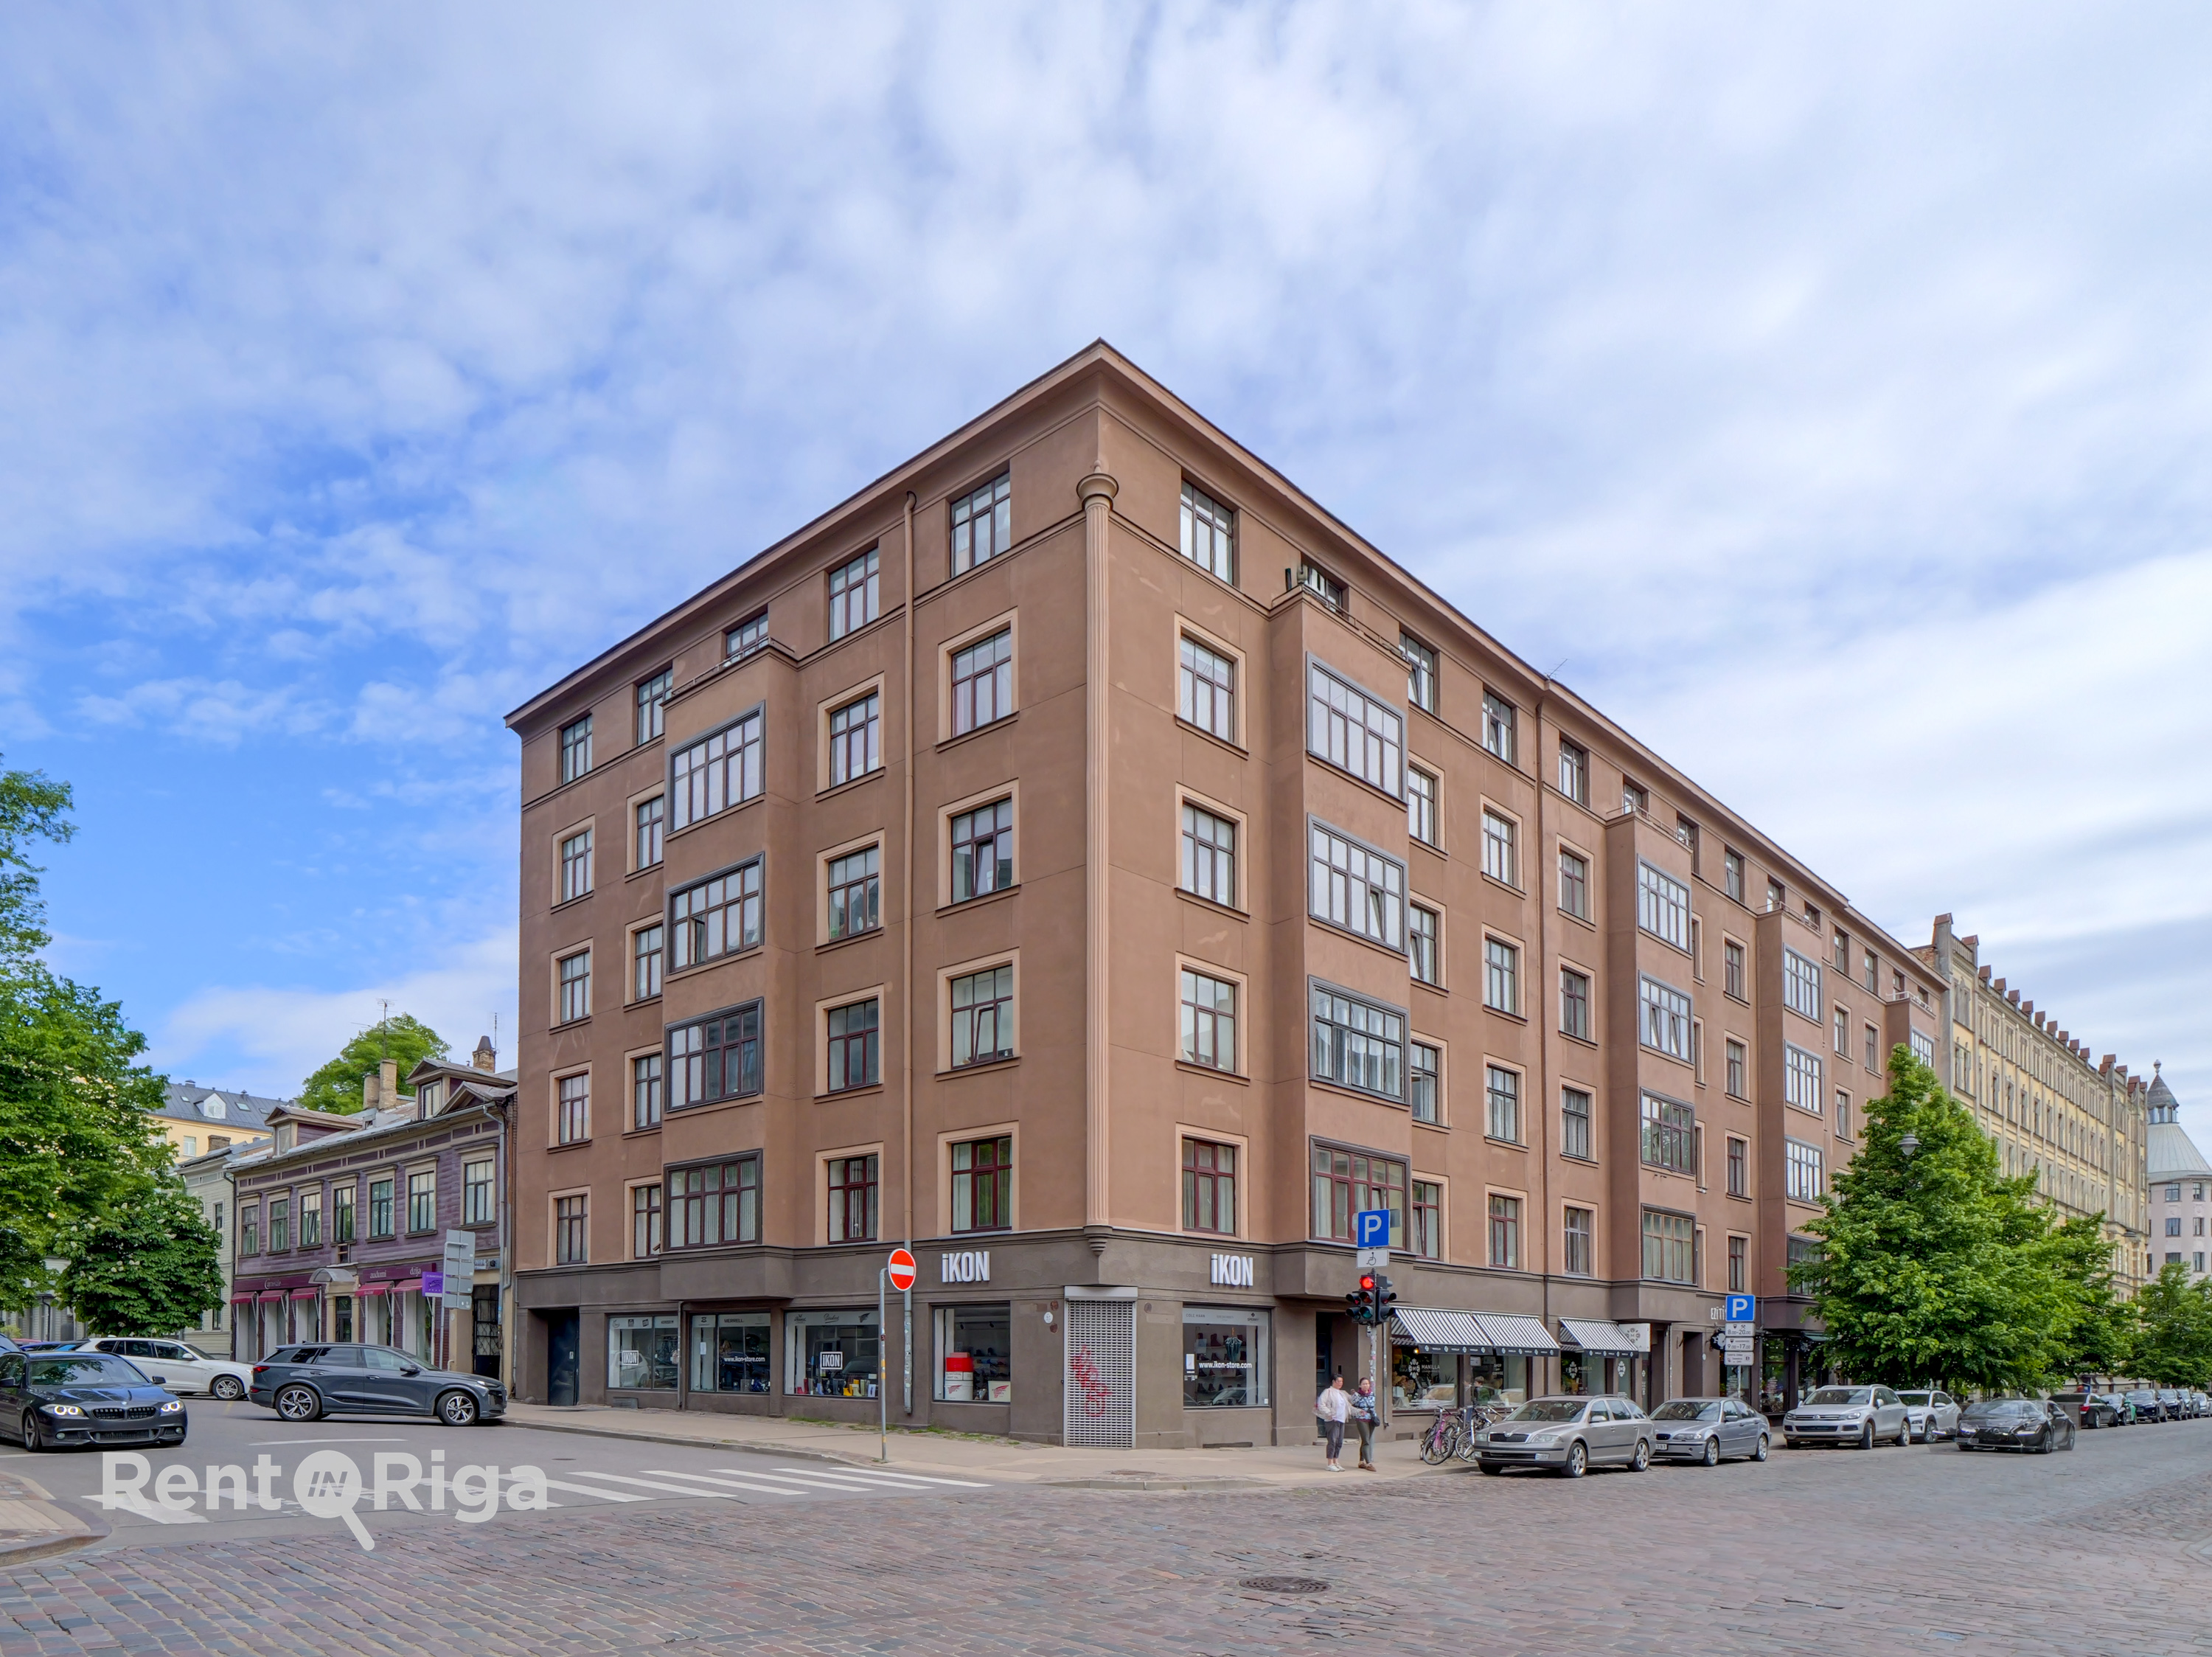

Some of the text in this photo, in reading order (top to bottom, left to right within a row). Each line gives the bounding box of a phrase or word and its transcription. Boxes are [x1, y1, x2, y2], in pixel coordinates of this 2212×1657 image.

[1364, 1215, 1382, 1243] P
[1732, 1298, 1748, 1319] P
[1199, 1361, 1252, 1369] www.ikon-store.com
